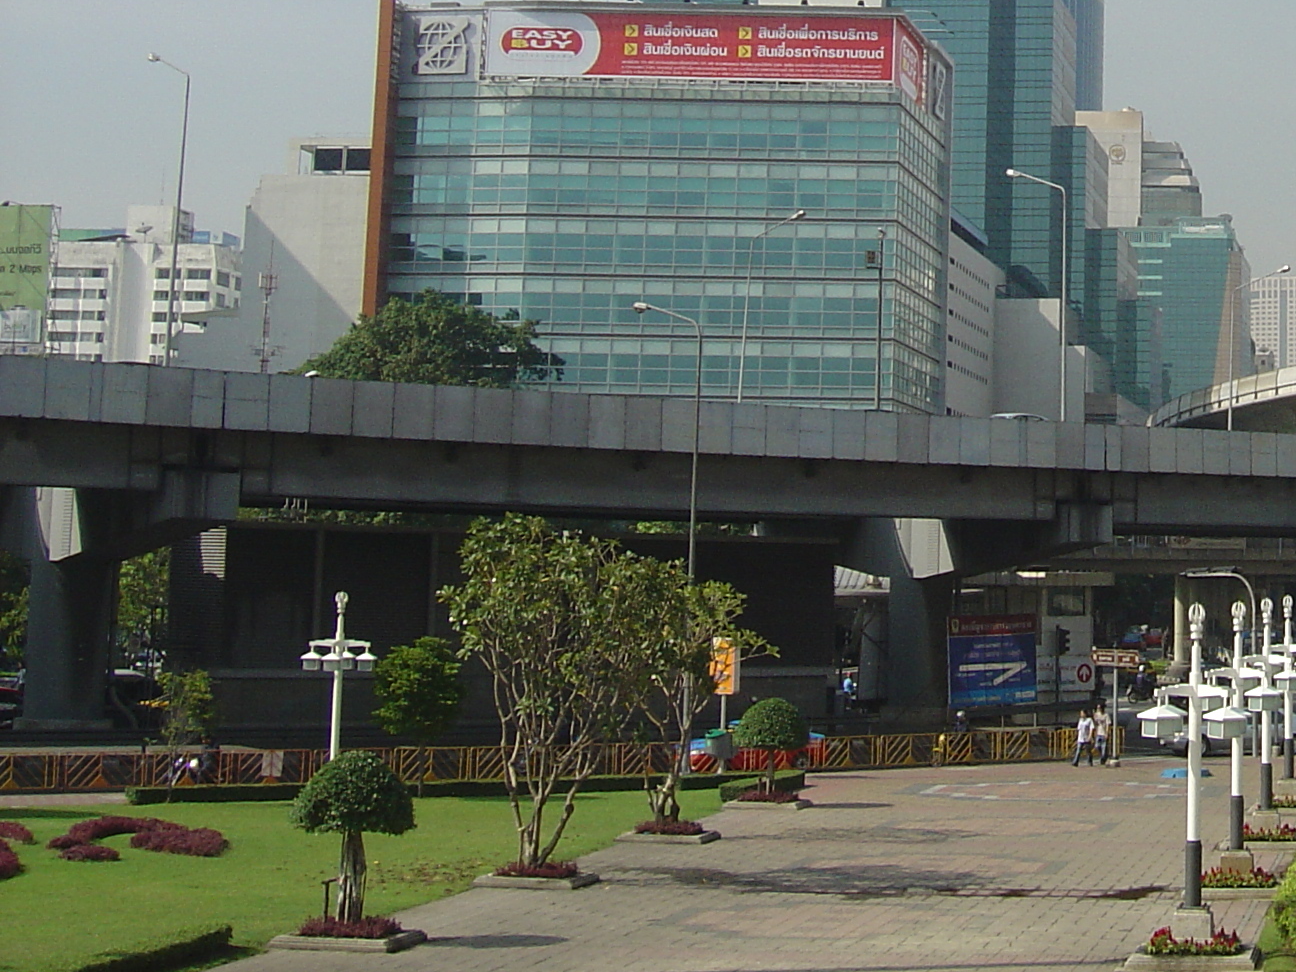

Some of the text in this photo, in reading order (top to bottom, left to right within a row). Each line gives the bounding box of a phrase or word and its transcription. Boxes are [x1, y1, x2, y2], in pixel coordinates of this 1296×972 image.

[511, 29, 573, 40] EASY
[643, 22, 718, 38] สินเชื่อเงินสด
[758, 24, 879, 40] สินเชื่อเพื่อการบริการ
[511, 39, 573, 49] BUY
[643, 40, 728, 57] สินเชื่อเงินผ่อน
[9, 264, 15, 273] 2
